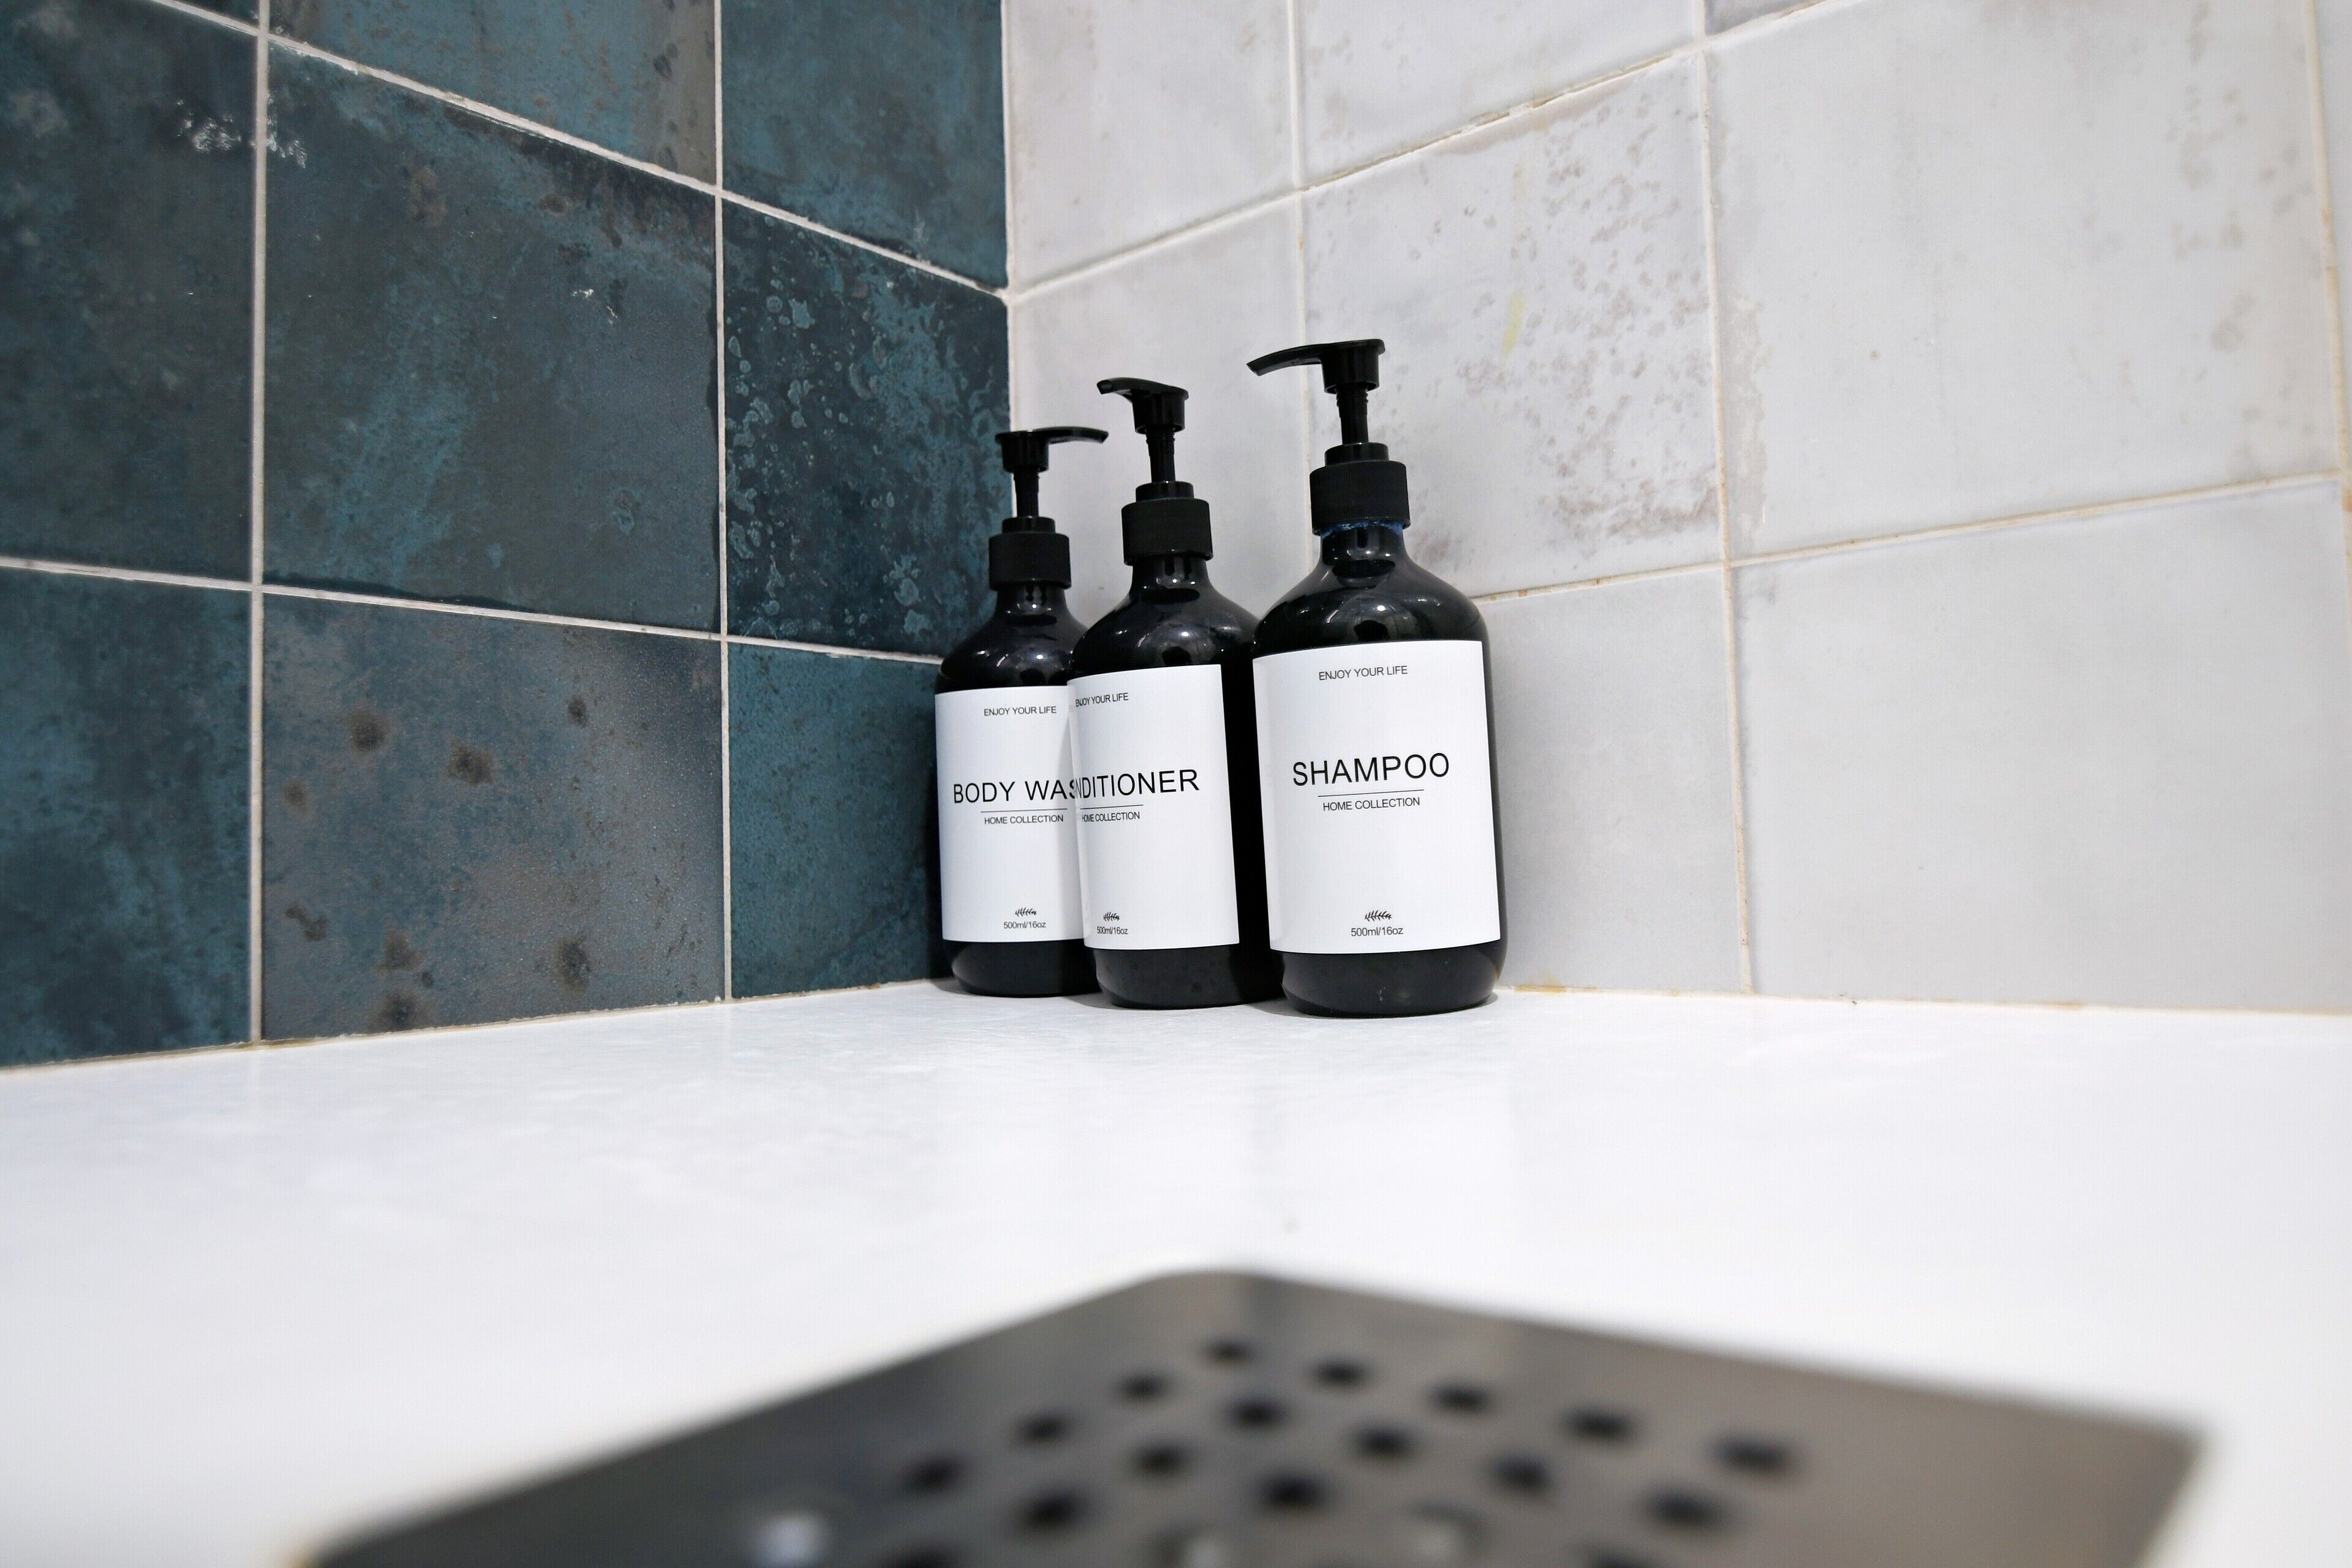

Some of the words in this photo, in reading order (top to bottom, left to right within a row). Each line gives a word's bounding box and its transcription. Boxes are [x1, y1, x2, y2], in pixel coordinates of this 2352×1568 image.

[1319, 669, 1351, 680] ENJOY
[1354, 667, 1384, 677] YOUR
[1387, 666, 1408, 675] LIFE
[1076, 698, 1090, 707] ENJOY
[1091, 695, 1110, 704] YOUR
[1112, 693, 1129, 702] LIFE
[1292, 753, 1449, 786] SHAMPOO
[954, 782, 1016, 803] BODY
[1323, 801, 1352, 811] HOME
[1355, 797, 1420, 809] COLLECTION
[1010, 815, 1064, 824] COLLECTION
[1095, 812, 1140, 822] COLLECTION
[1097, 926, 1128, 935] 500ml/16oz
[1351, 927, 1403, 937] 500ml/16oz
